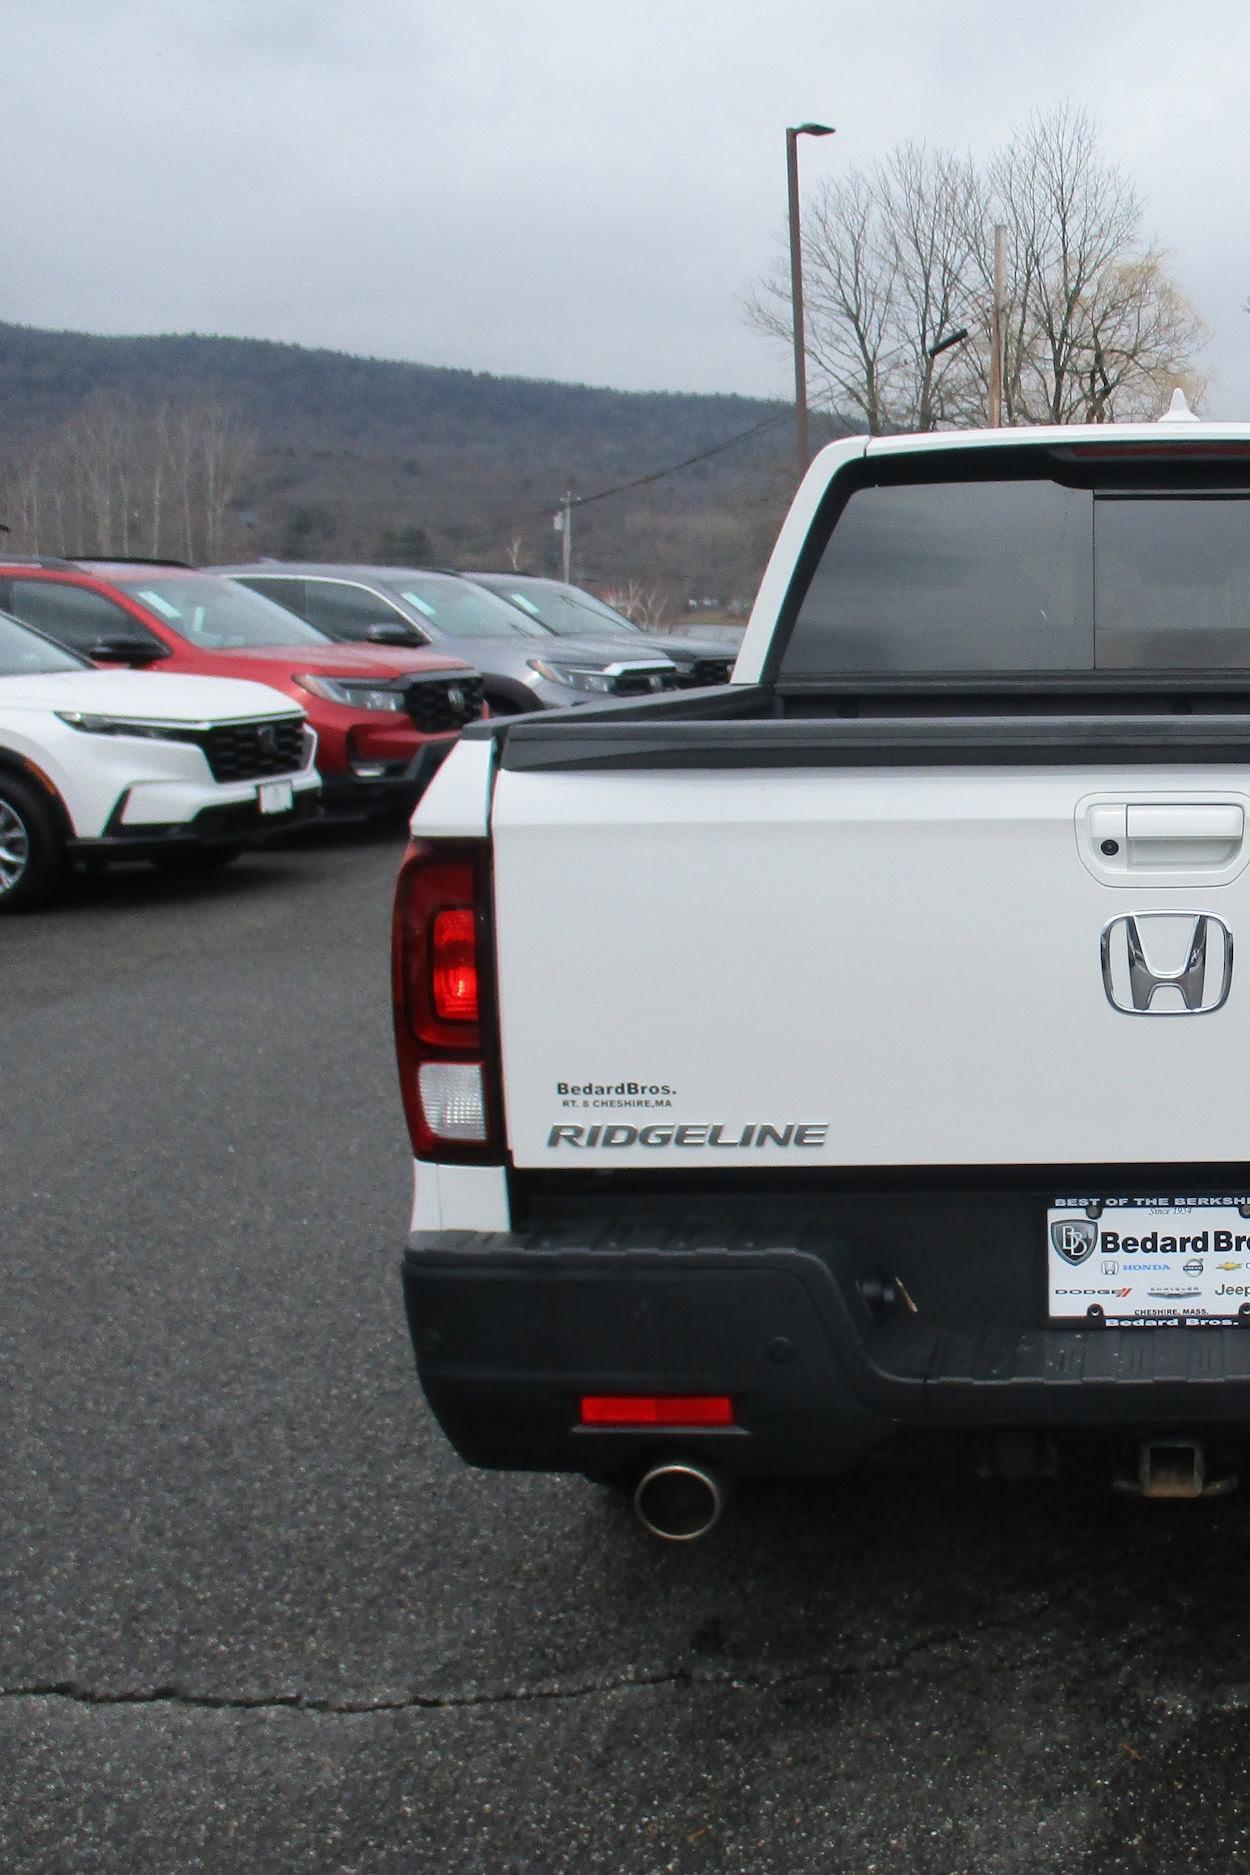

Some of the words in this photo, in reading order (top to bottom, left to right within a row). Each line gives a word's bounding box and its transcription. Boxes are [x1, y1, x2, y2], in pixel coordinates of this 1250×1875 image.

[562, 1099, 579, 1108] RT.
[547, 1122, 829, 1148] RIDGELINE
[1055, 1198, 1100, 1207] BEST
[1105, 1198, 1128, 1206] OF
[1133, 1197, 1169, 1206] THE
[1149, 1207, 1170, 1216] Since
[1101, 1231, 1209, 1253] Bedard
[1134, 1308, 1181, 1316] CHESHIRE,
[1105, 1318, 1179, 1327] Bedard
[1185, 1317, 1239, 1326] Bros.
